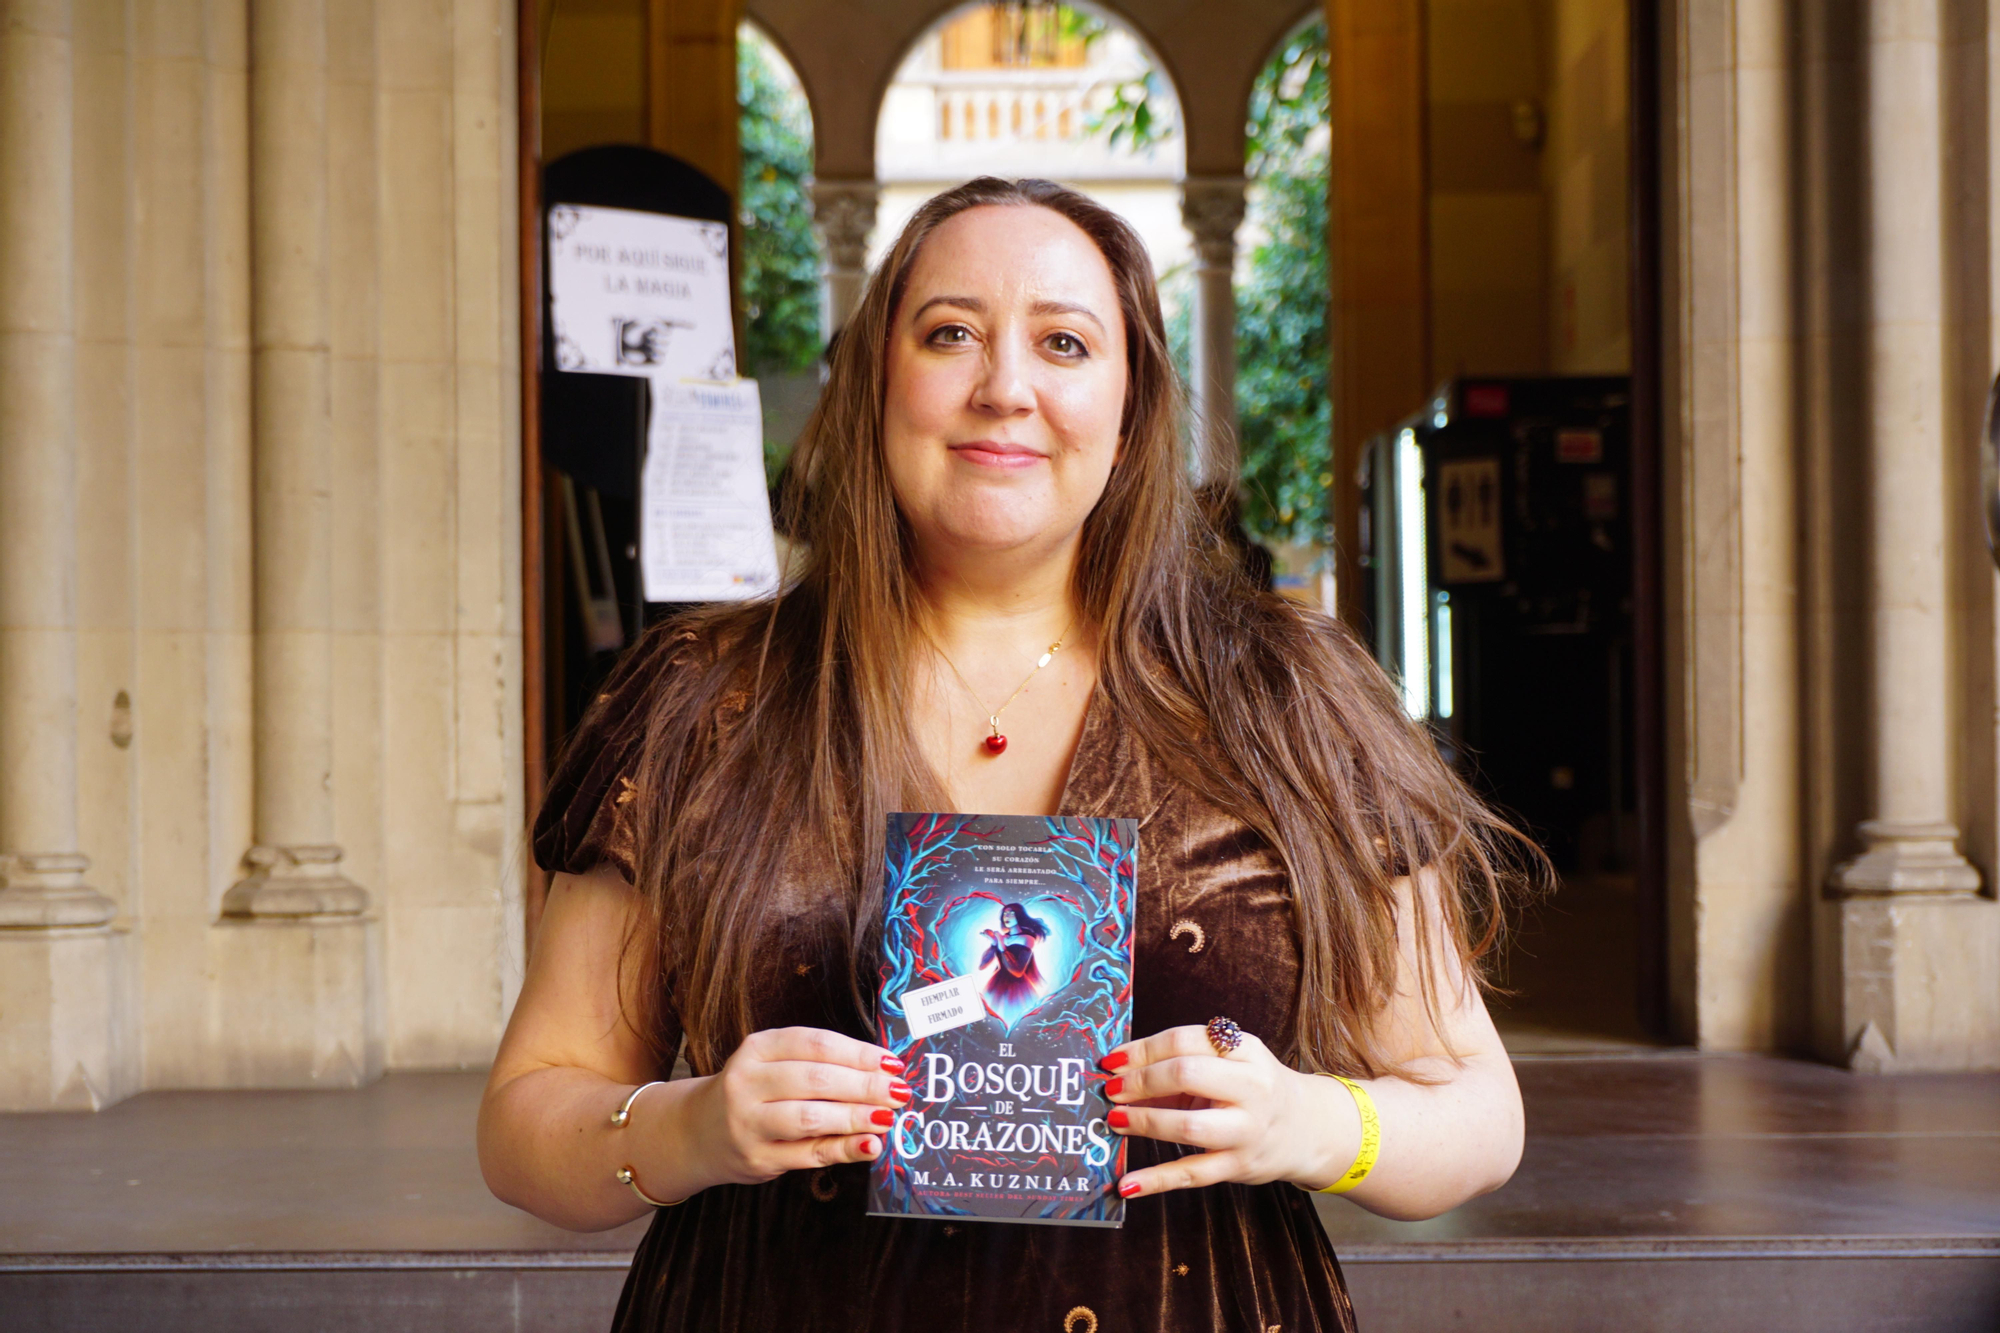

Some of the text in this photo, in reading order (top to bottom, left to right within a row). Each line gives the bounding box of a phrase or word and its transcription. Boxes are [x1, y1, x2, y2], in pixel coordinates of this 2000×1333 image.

[603, 274, 629, 293] LA
[986, 865, 1006, 873] SERÁ
[1007, 867, 1057, 875] ARREBATADO
[921, 987, 960, 1007] EJEMPLAR
[927, 1005, 964, 1024] FIRMADO
[999, 1043, 1016, 1057] EL
[922, 1052, 1085, 1106] BOSQUE
[995, 1100, 1014, 1115] DE
[894, 1111, 1111, 1166] CORAZONES
[970, 1173, 1090, 1192] KUZNIAR
